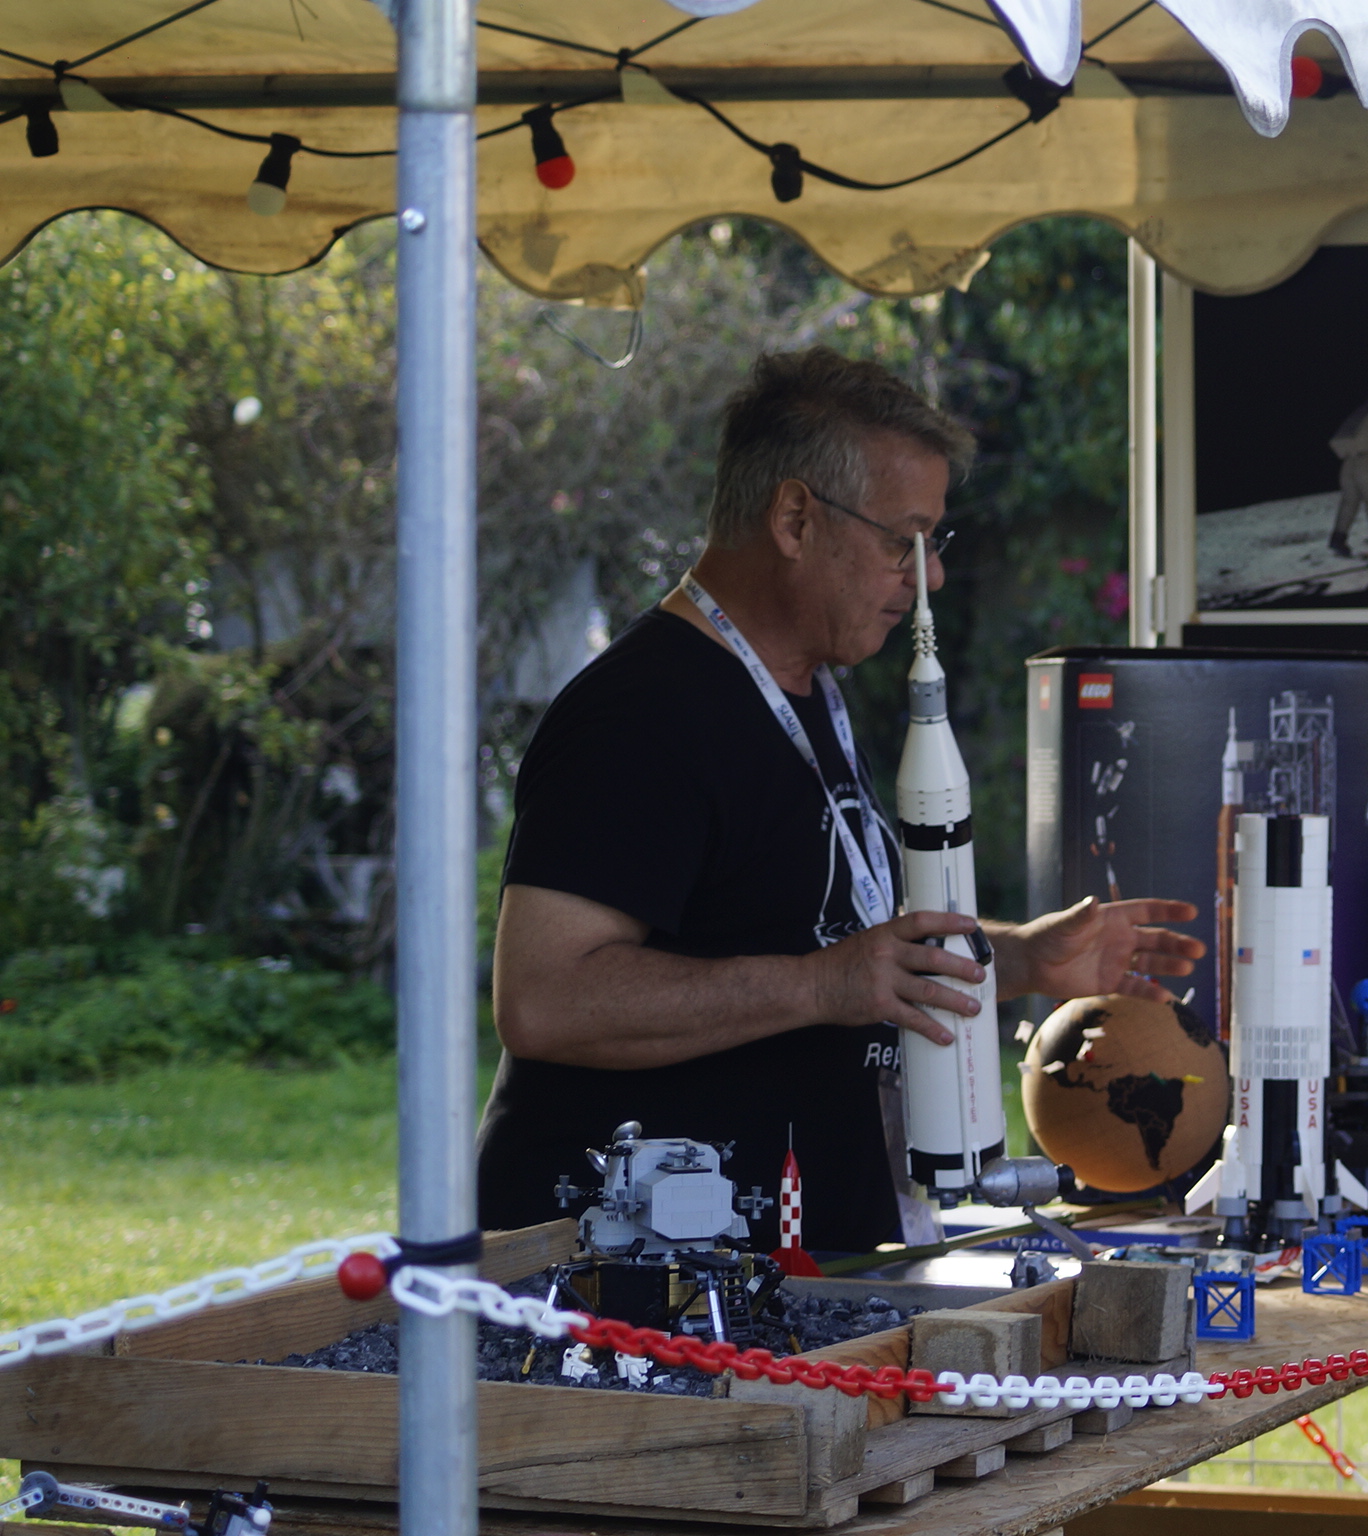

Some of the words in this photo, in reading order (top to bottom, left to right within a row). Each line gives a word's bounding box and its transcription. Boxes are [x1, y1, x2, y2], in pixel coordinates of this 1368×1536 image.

[1081, 683, 1112, 698] LEGO
[1240, 1079, 1250, 1128] USA
[1308, 1080, 1318, 1129] USA
